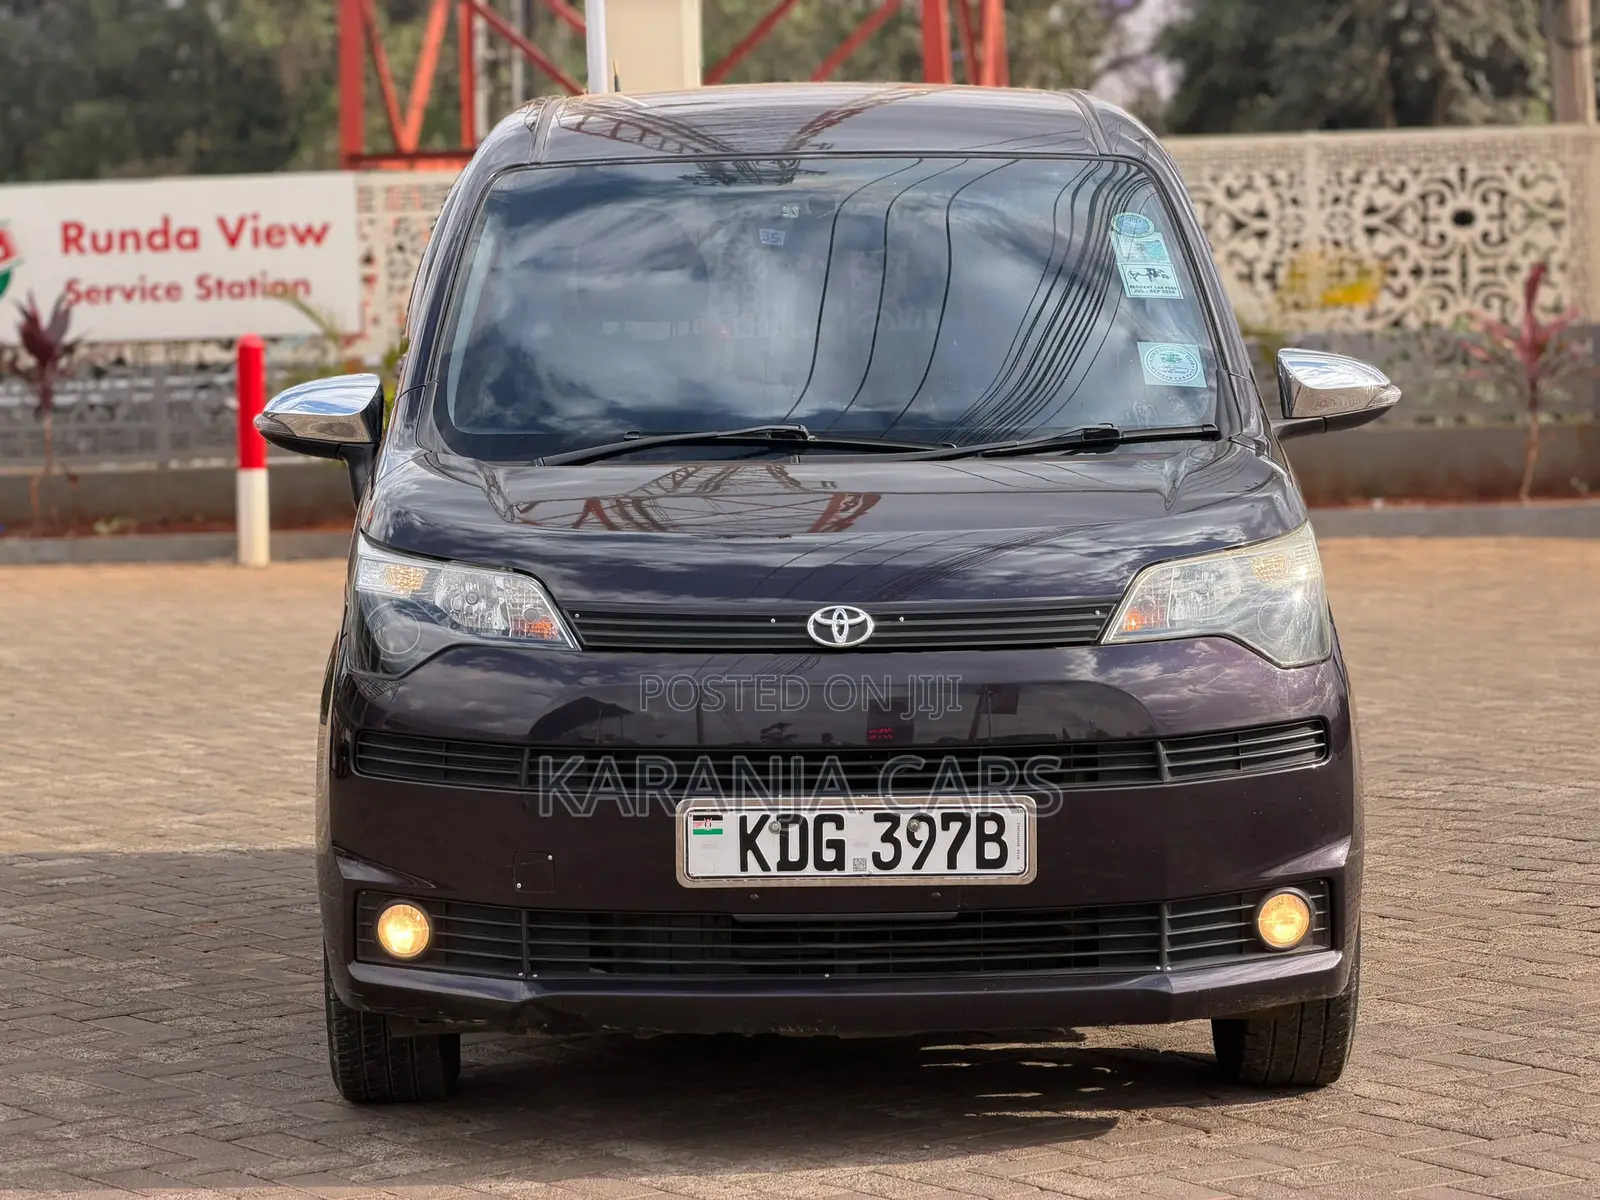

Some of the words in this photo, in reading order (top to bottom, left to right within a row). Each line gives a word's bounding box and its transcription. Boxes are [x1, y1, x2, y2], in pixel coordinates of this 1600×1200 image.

[61, 214, 200, 255] Runda
[217, 212, 331, 249] View
[65, 276, 182, 306] Service
[195, 271, 311, 299] Station
[738, 812, 846, 873] KDG
[870, 811, 1009, 871] 397B
